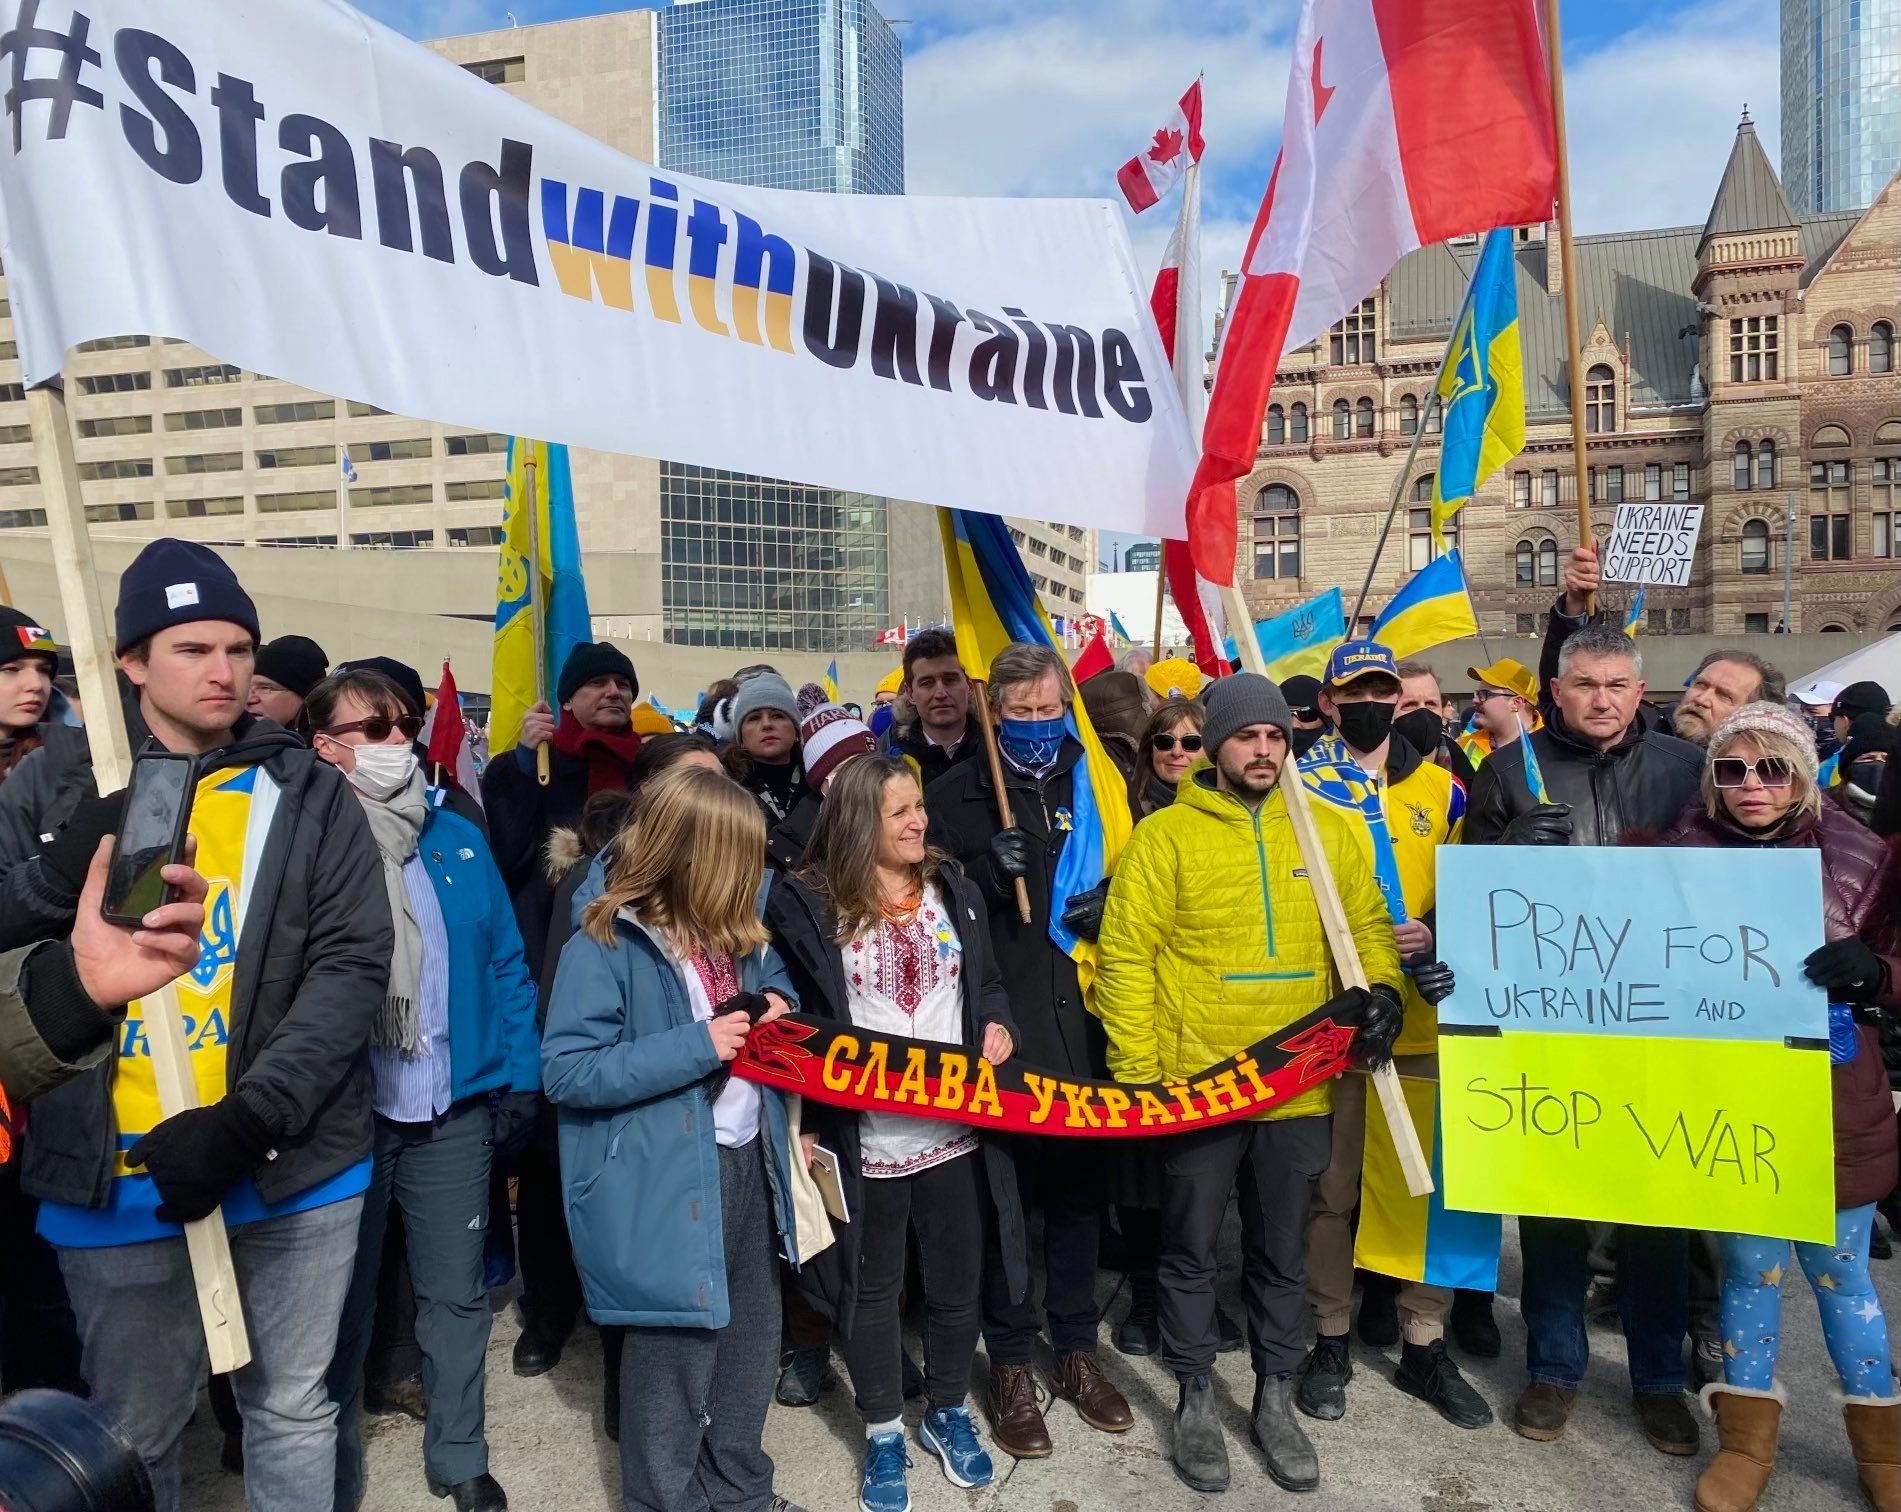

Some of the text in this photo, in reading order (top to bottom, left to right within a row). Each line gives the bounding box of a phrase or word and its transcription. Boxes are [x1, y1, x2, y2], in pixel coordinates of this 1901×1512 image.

[1616, 506, 1699, 531] UKRAINE
[1611, 531, 1690, 556] NEEDS
[1604, 555, 1692, 584] SUPPORT
[1343, 653, 1388, 666] UKRAINE
[1489, 888, 1632, 983] PRAY
[1663, 925, 1781, 988] FOR
[1485, 982, 1746, 1027] UKRAINE AND
[822, 1034, 1276, 1129] СЛАВА УКРАЇНІ
[1622, 1102, 1780, 1195] WAR
